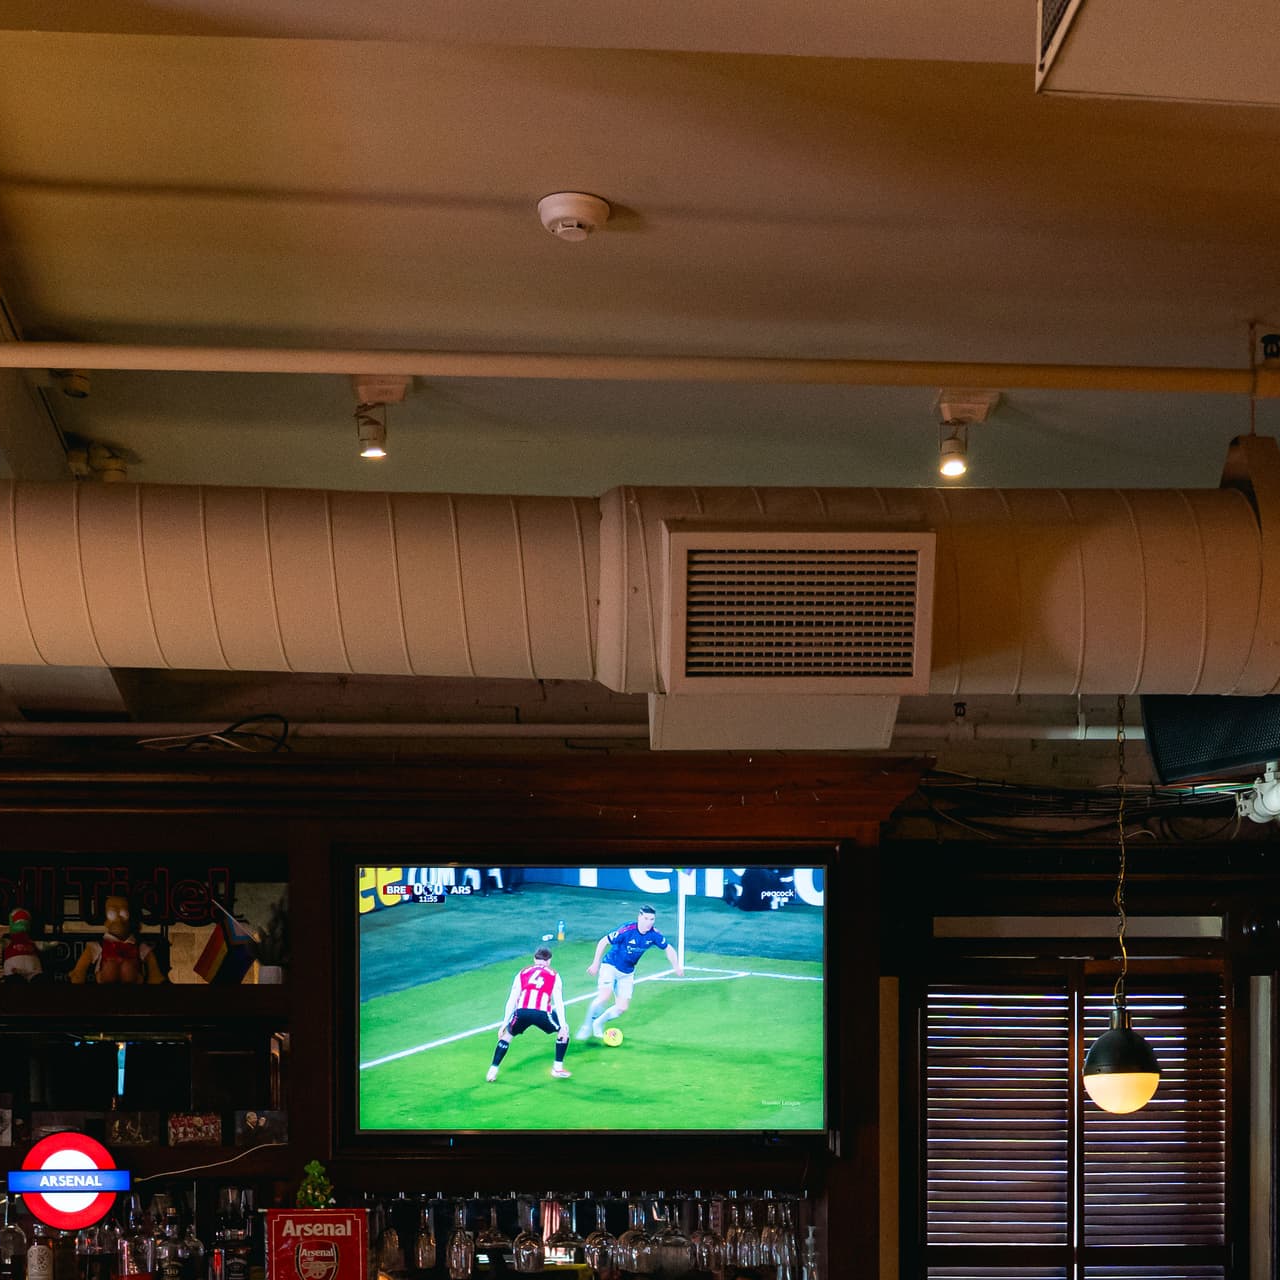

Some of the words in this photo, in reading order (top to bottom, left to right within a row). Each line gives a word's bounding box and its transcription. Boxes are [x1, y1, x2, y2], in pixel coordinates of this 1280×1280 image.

[387, 886, 407, 894] BRE
[451, 886, 471, 895] ARS
[761, 889, 794, 900] peacock
[527, 969, 545, 989] 4
[39, 1174, 103, 1187] ARSENAL
[282, 1219, 352, 1237] Arsenal
[301, 1248, 335, 1257] Arsenal
